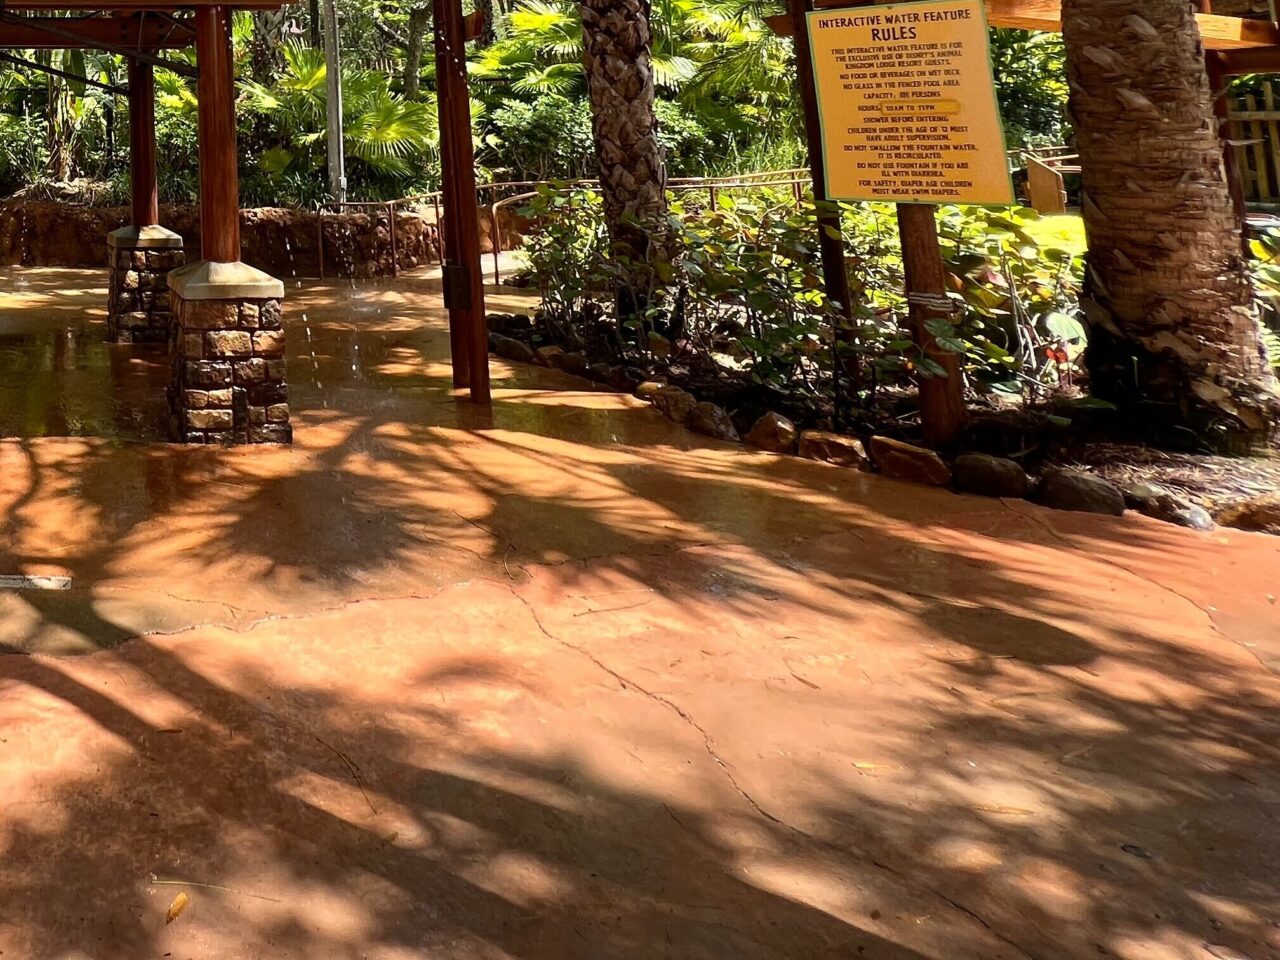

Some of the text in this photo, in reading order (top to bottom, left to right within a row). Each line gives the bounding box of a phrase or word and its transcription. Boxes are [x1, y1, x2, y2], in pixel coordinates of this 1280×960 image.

[819, 9, 971, 28] INTERACTIVE WATER FEATURE
[872, 26, 917, 42] RULES
[846, 46, 884, 54] INTERACTIVE
